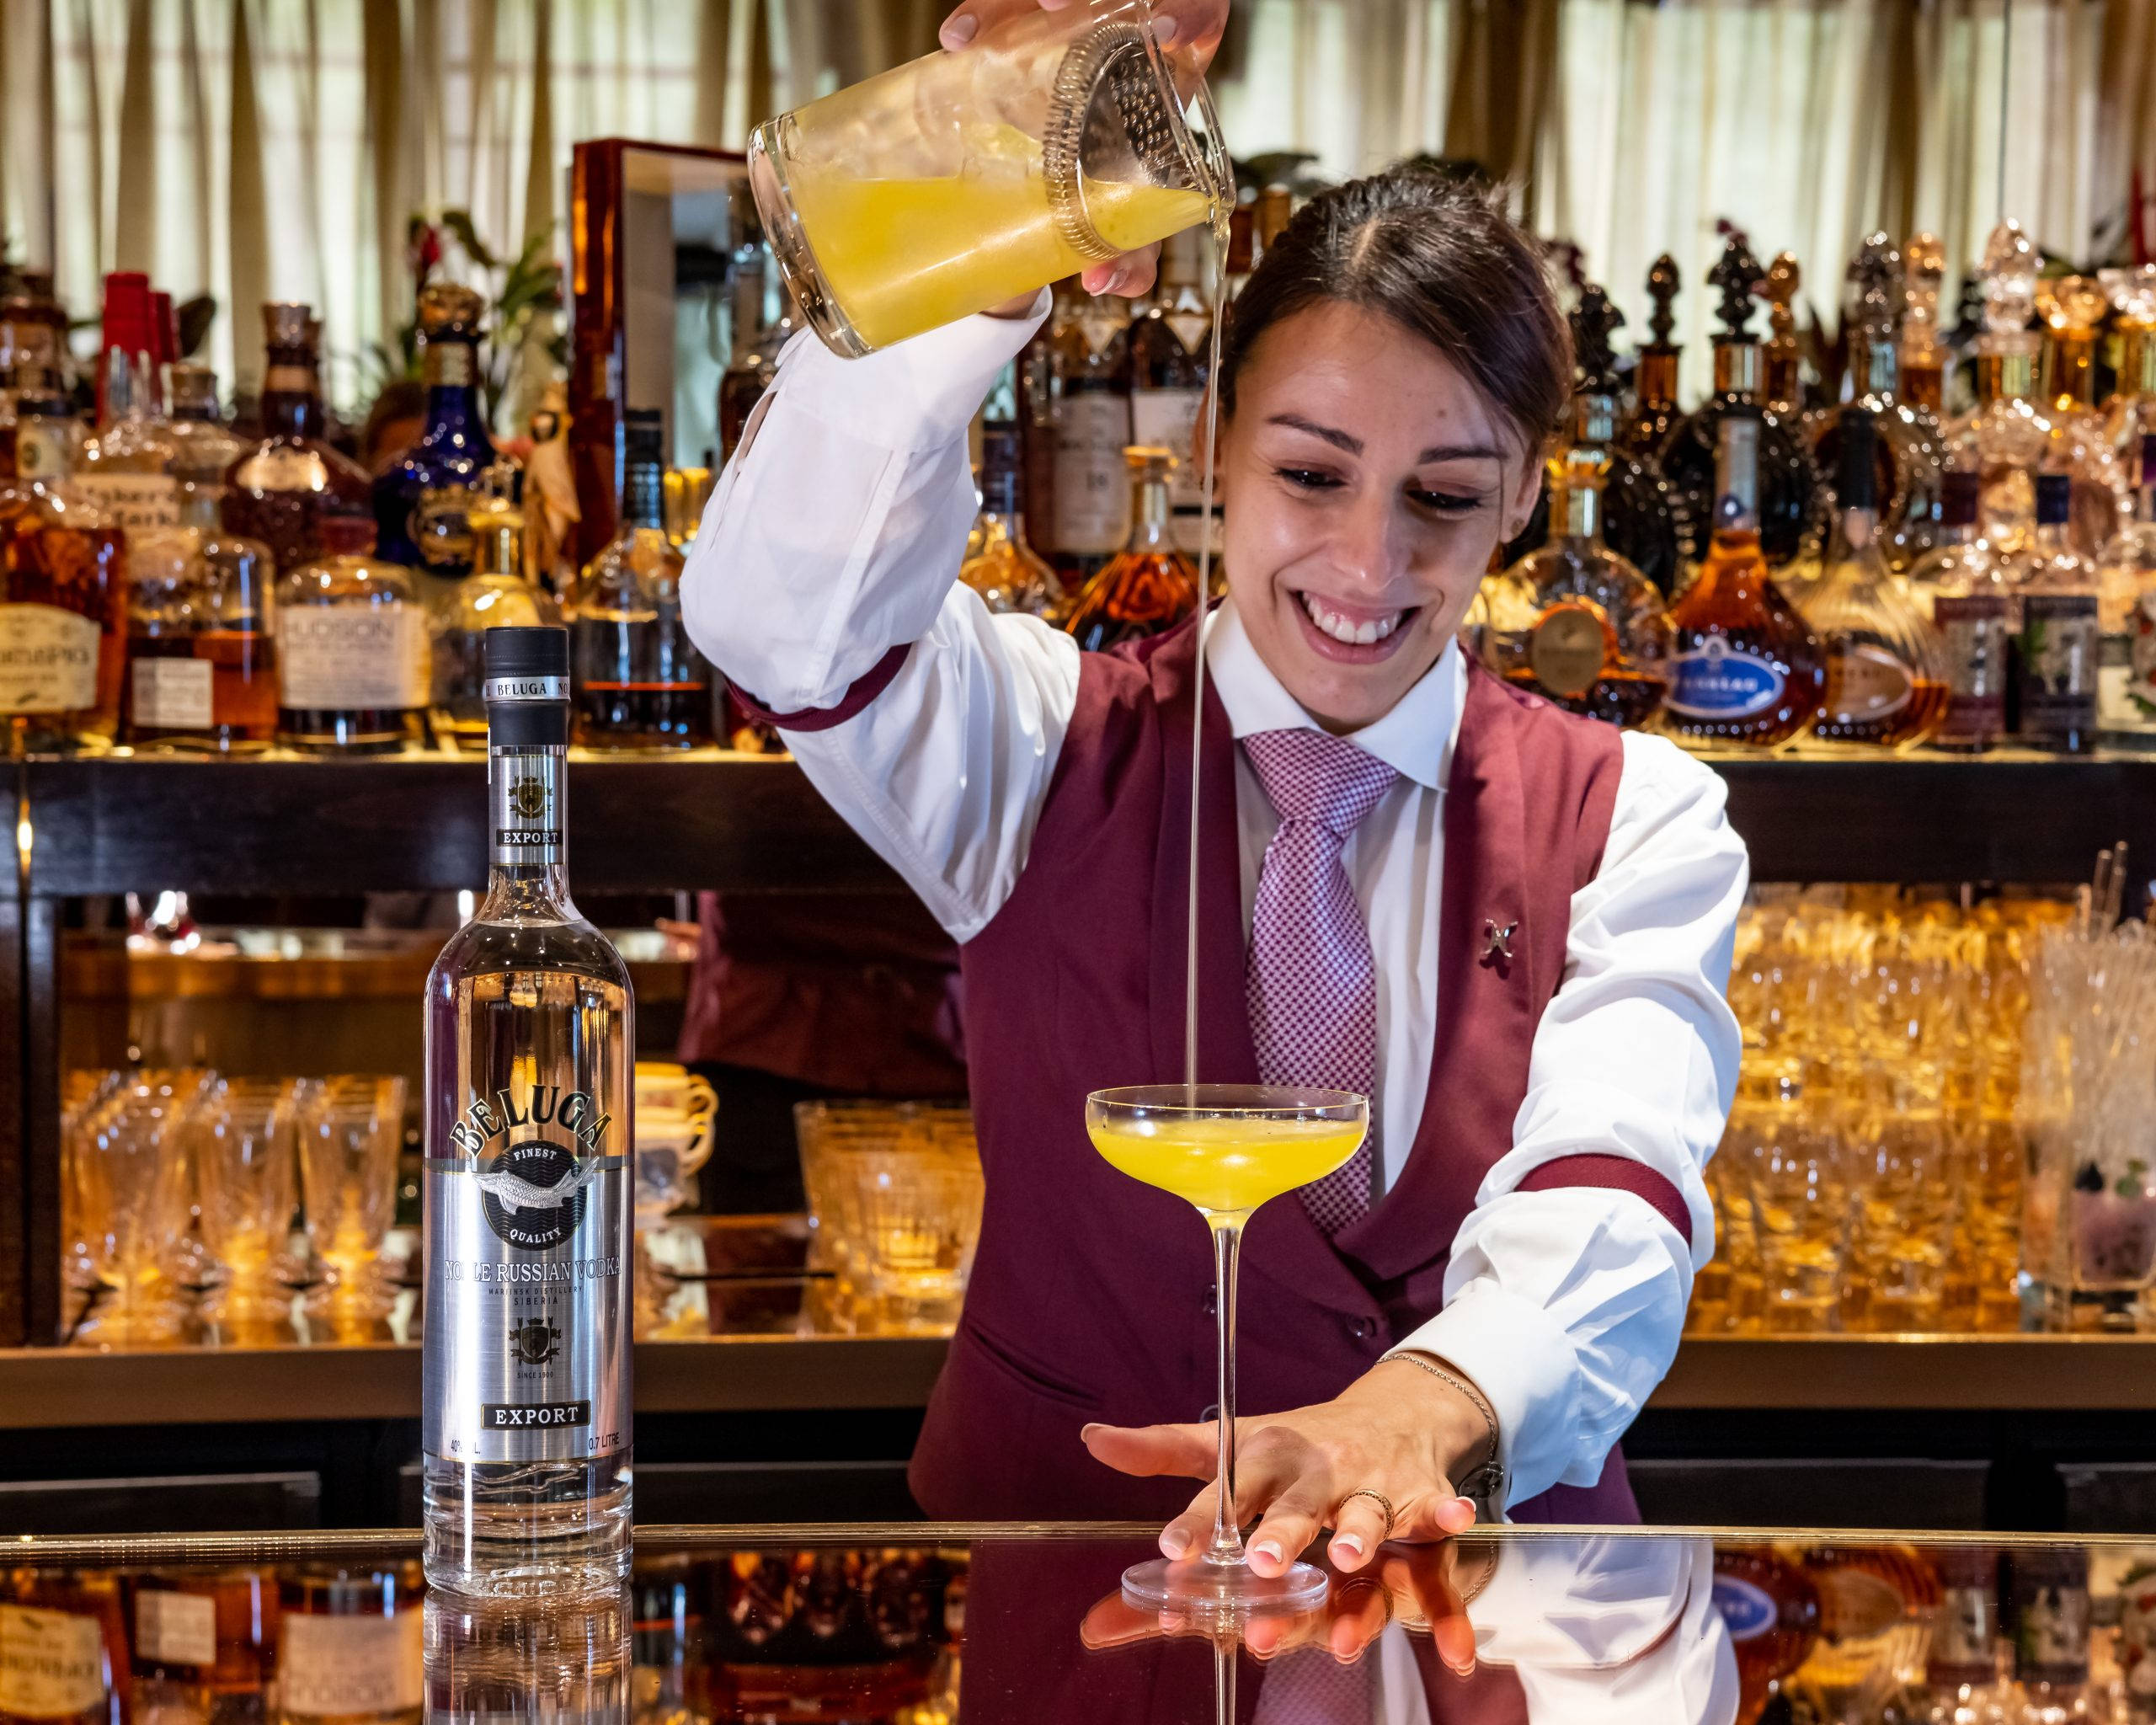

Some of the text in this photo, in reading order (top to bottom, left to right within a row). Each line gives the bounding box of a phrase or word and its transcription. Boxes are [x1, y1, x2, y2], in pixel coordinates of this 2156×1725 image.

[498, 683, 547, 696] BELUGA
[504, 832, 558, 843] EXPORT
[449, 1084, 612, 1159] BELUGA
[513, 1147, 558, 1162] FINEST
[510, 1226, 562, 1244] QUALITY
[445, 1255, 623, 1283] NOLE RUSSIAN VODKA
[534, 1285, 584, 1295] DISTILLERY
[514, 1296, 558, 1306] SIBERIA
[495, 1407, 579, 1424] EXPORT
[589, 1432, 620, 1450] 0.7 LITRE
